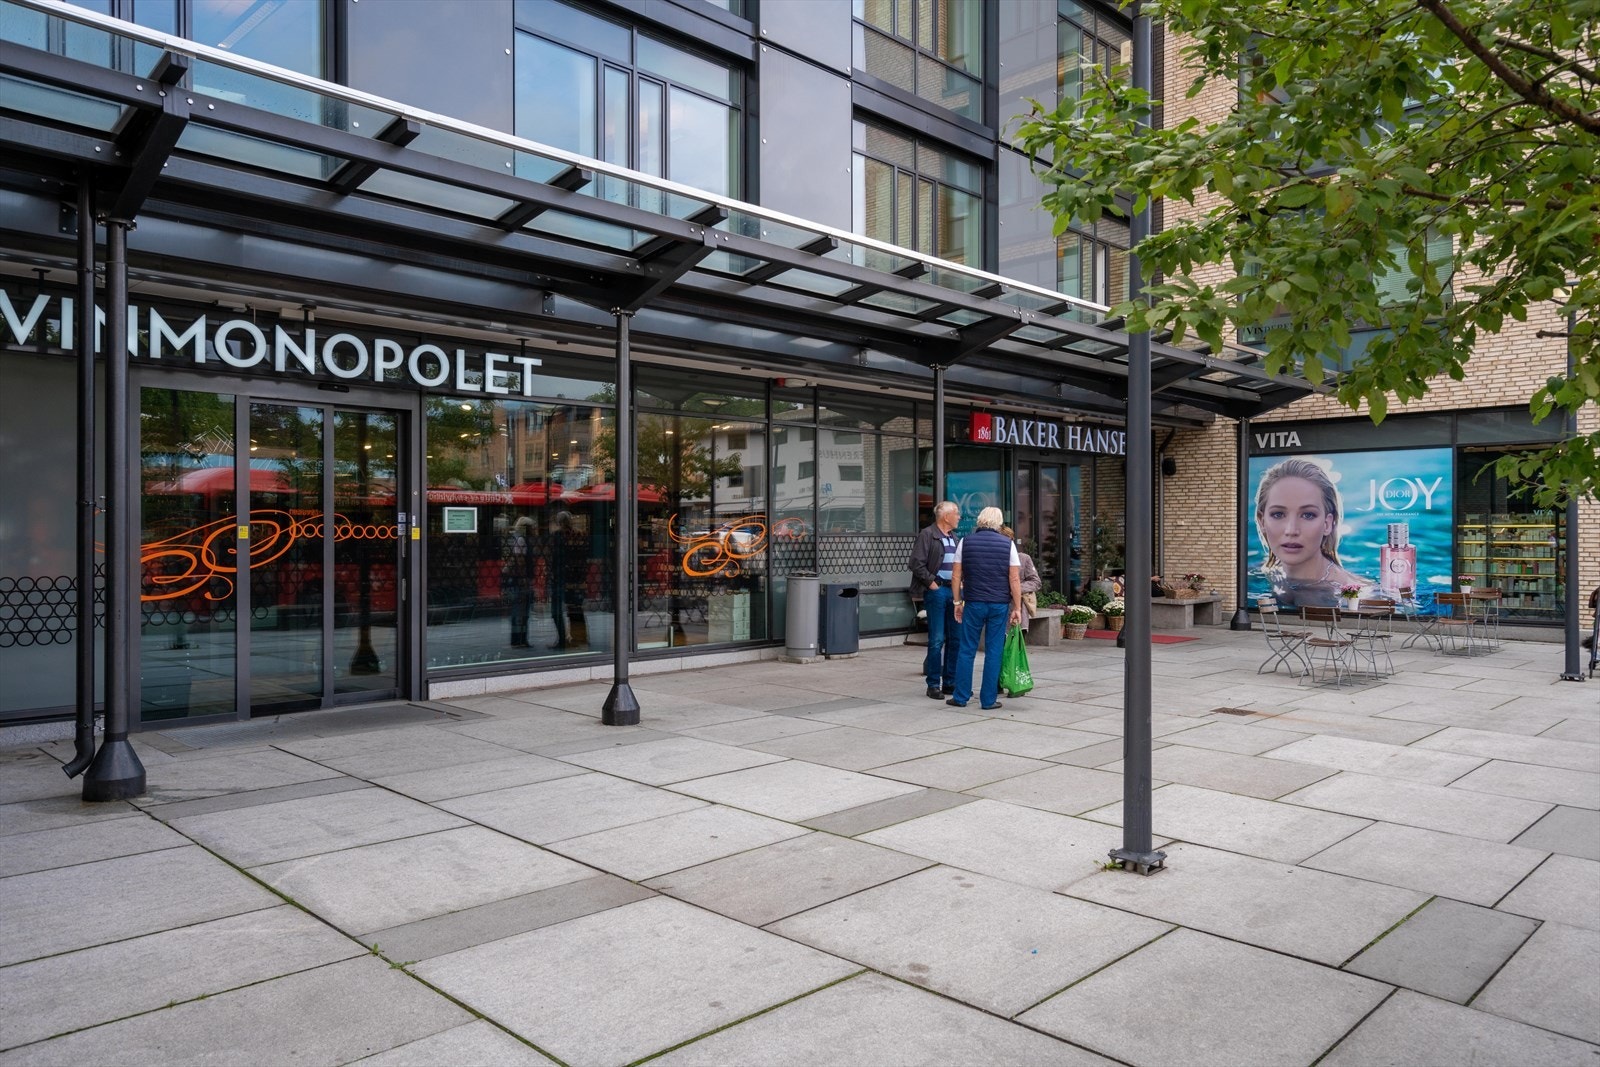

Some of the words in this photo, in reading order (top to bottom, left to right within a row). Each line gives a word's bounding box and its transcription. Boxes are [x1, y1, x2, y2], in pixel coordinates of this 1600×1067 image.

[0, 288, 542, 397] VINMONOPOLET
[994, 416, 1061, 449] BAKER
[1255, 431, 1302, 449] VITA
[1355, 476, 1443, 512] JOY
[1385, 490, 1411, 499] DIOR
